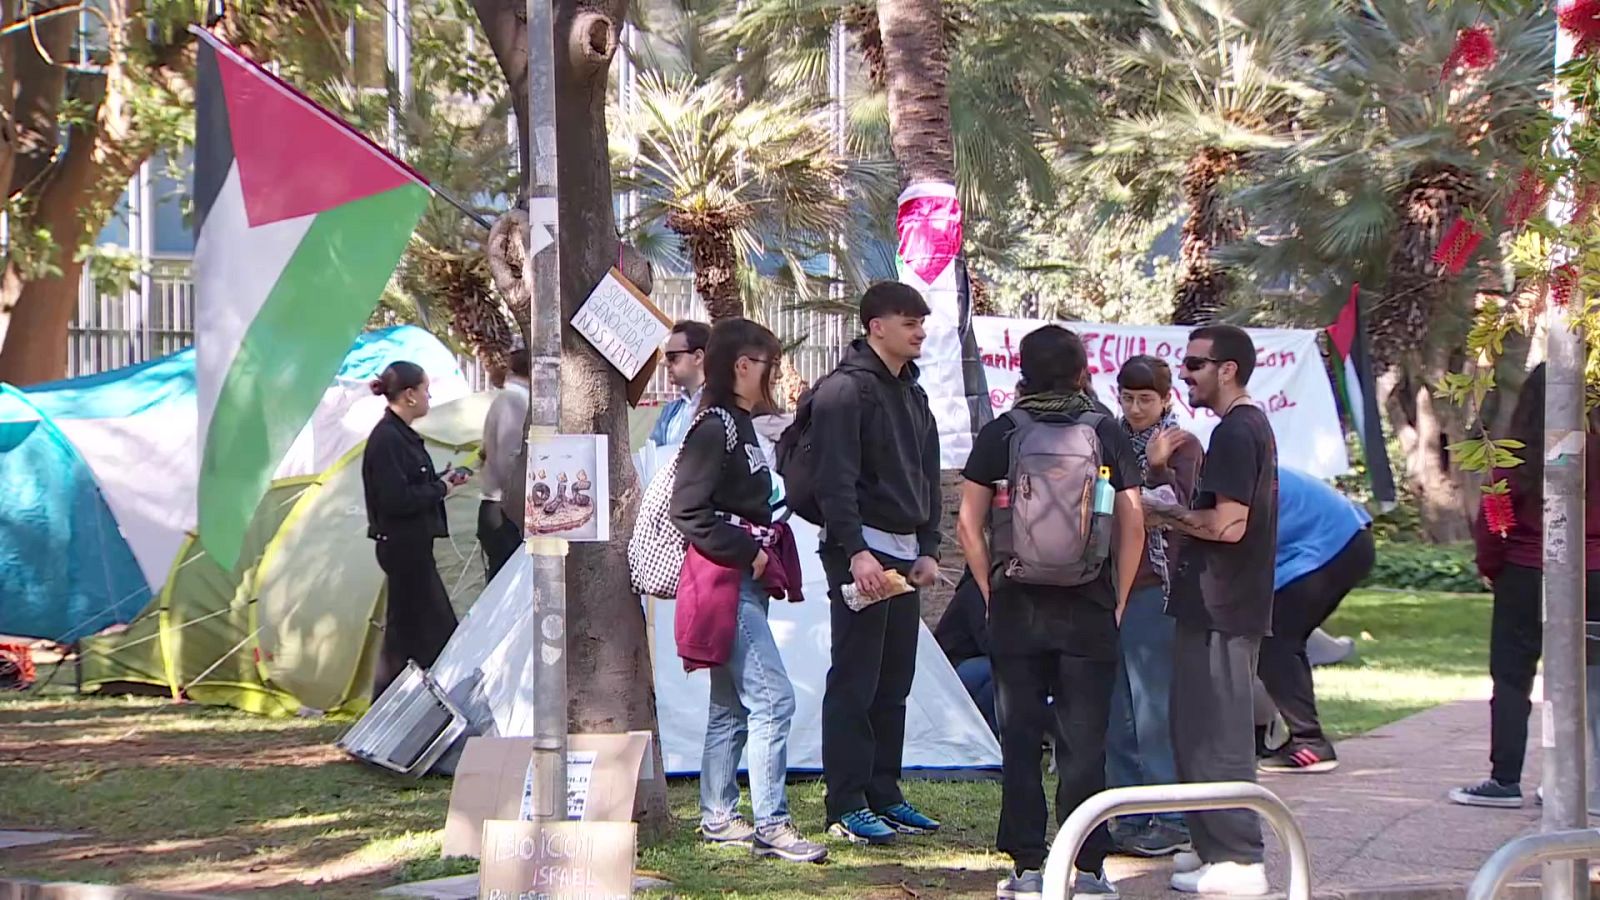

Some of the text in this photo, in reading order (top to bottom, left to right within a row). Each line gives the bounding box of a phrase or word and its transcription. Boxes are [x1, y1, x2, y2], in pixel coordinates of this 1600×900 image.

[587, 296, 644, 355] GENOCIDA
[603, 285, 657, 337] SIONISMO
[577, 312, 639, 377] NOS MATA
